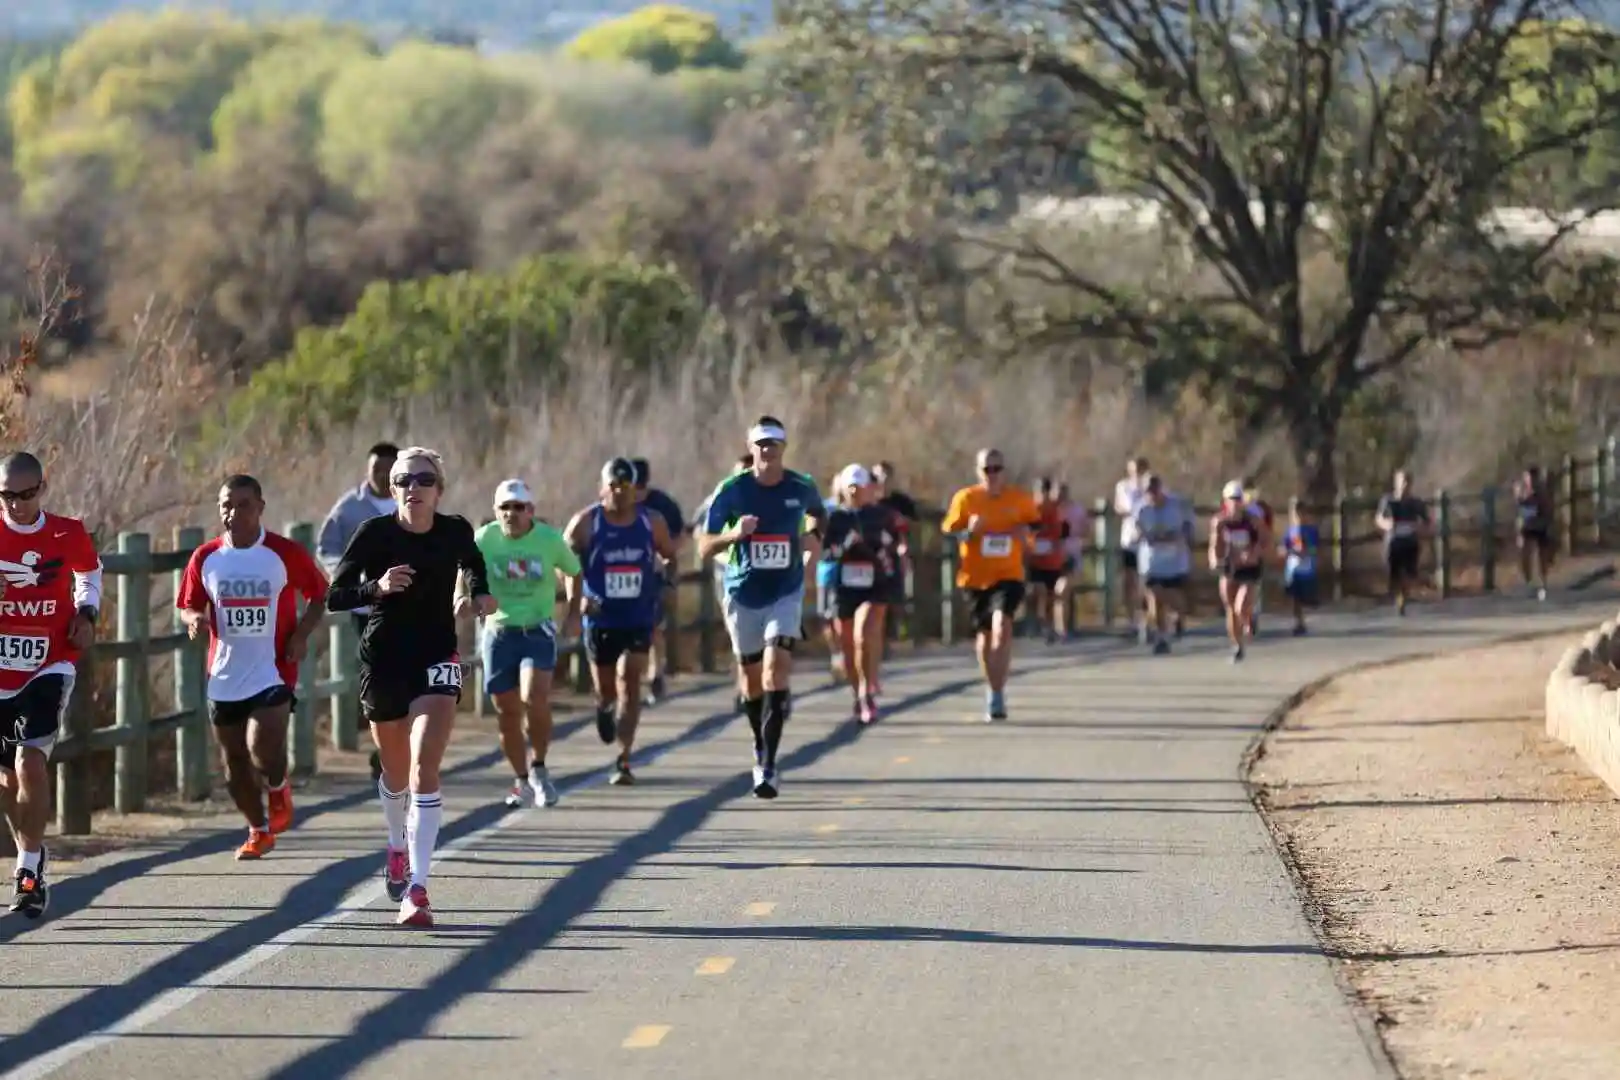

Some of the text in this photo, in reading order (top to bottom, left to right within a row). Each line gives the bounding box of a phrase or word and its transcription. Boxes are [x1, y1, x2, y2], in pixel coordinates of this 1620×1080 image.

[754, 544, 787, 559] 1571
[218, 580, 271, 597] 2014
[226, 608, 266, 627] 1939
[0, 636, 45, 660] 1505
